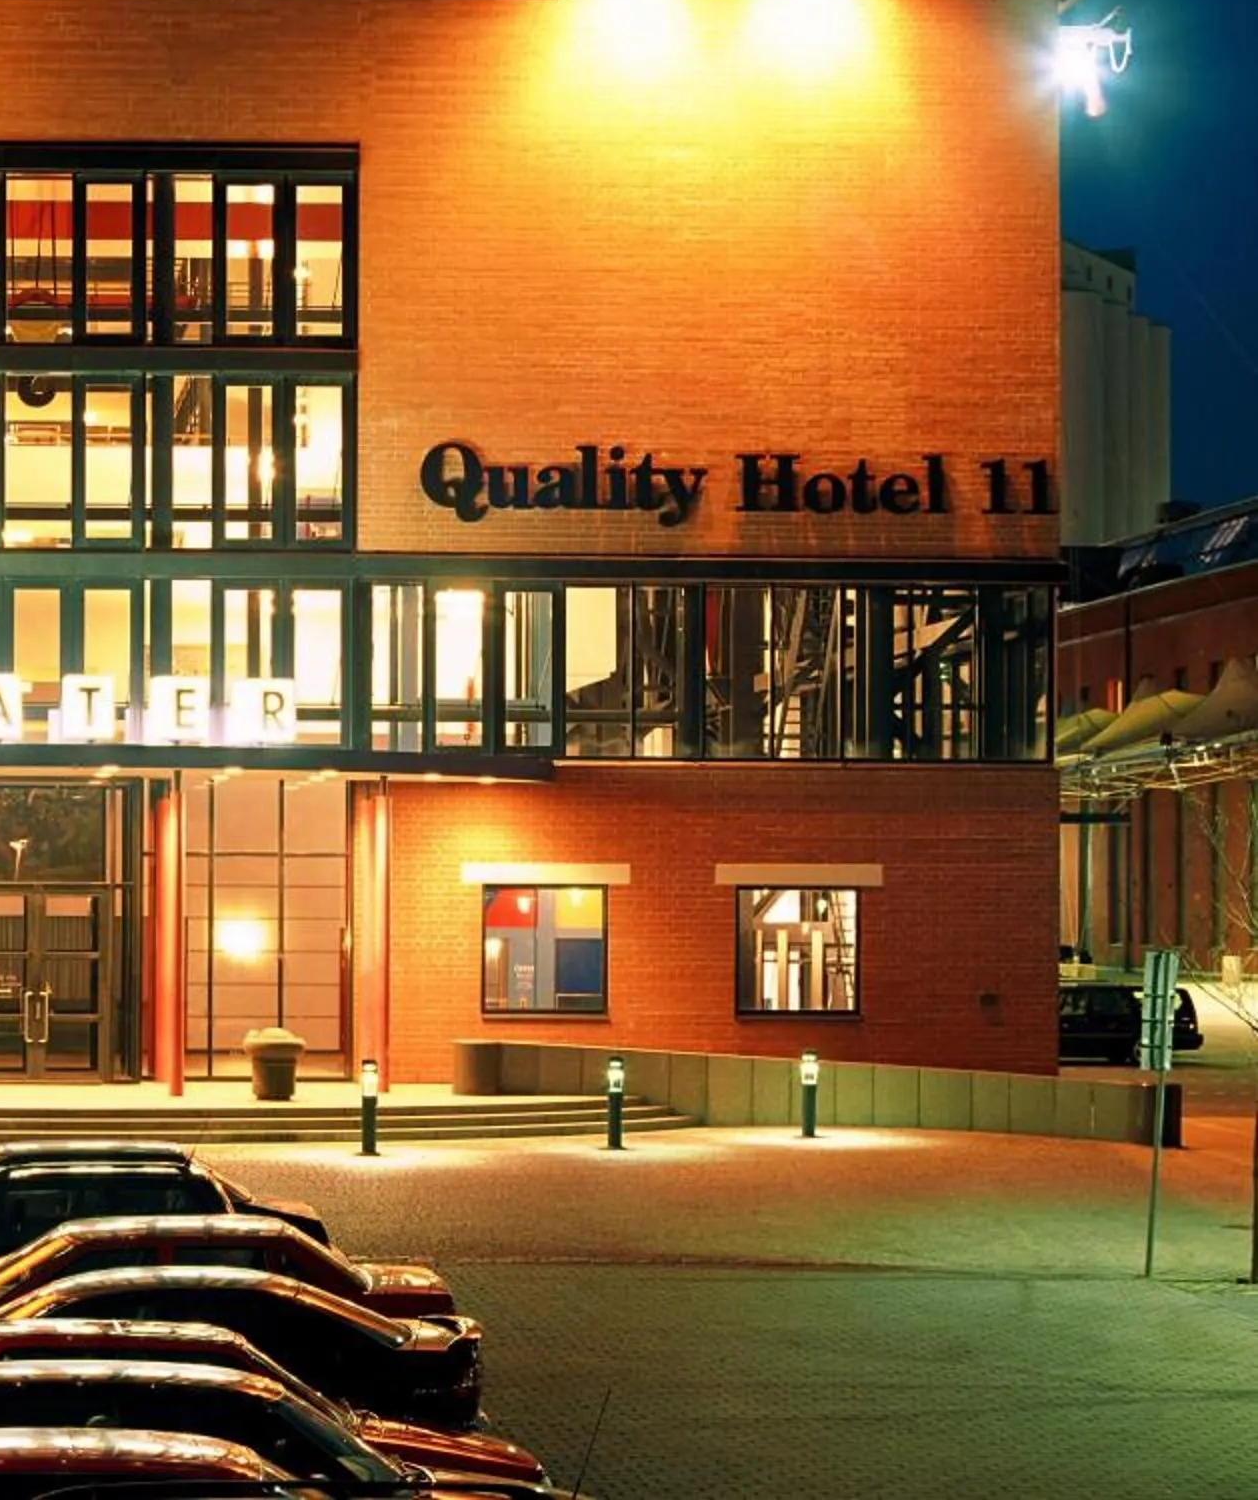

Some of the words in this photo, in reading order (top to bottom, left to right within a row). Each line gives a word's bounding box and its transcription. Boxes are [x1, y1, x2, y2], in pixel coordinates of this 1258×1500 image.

[420, 442, 707, 526] Quality
[735, 454, 948, 514] Hotel
[982, 459, 1058, 515] 11
